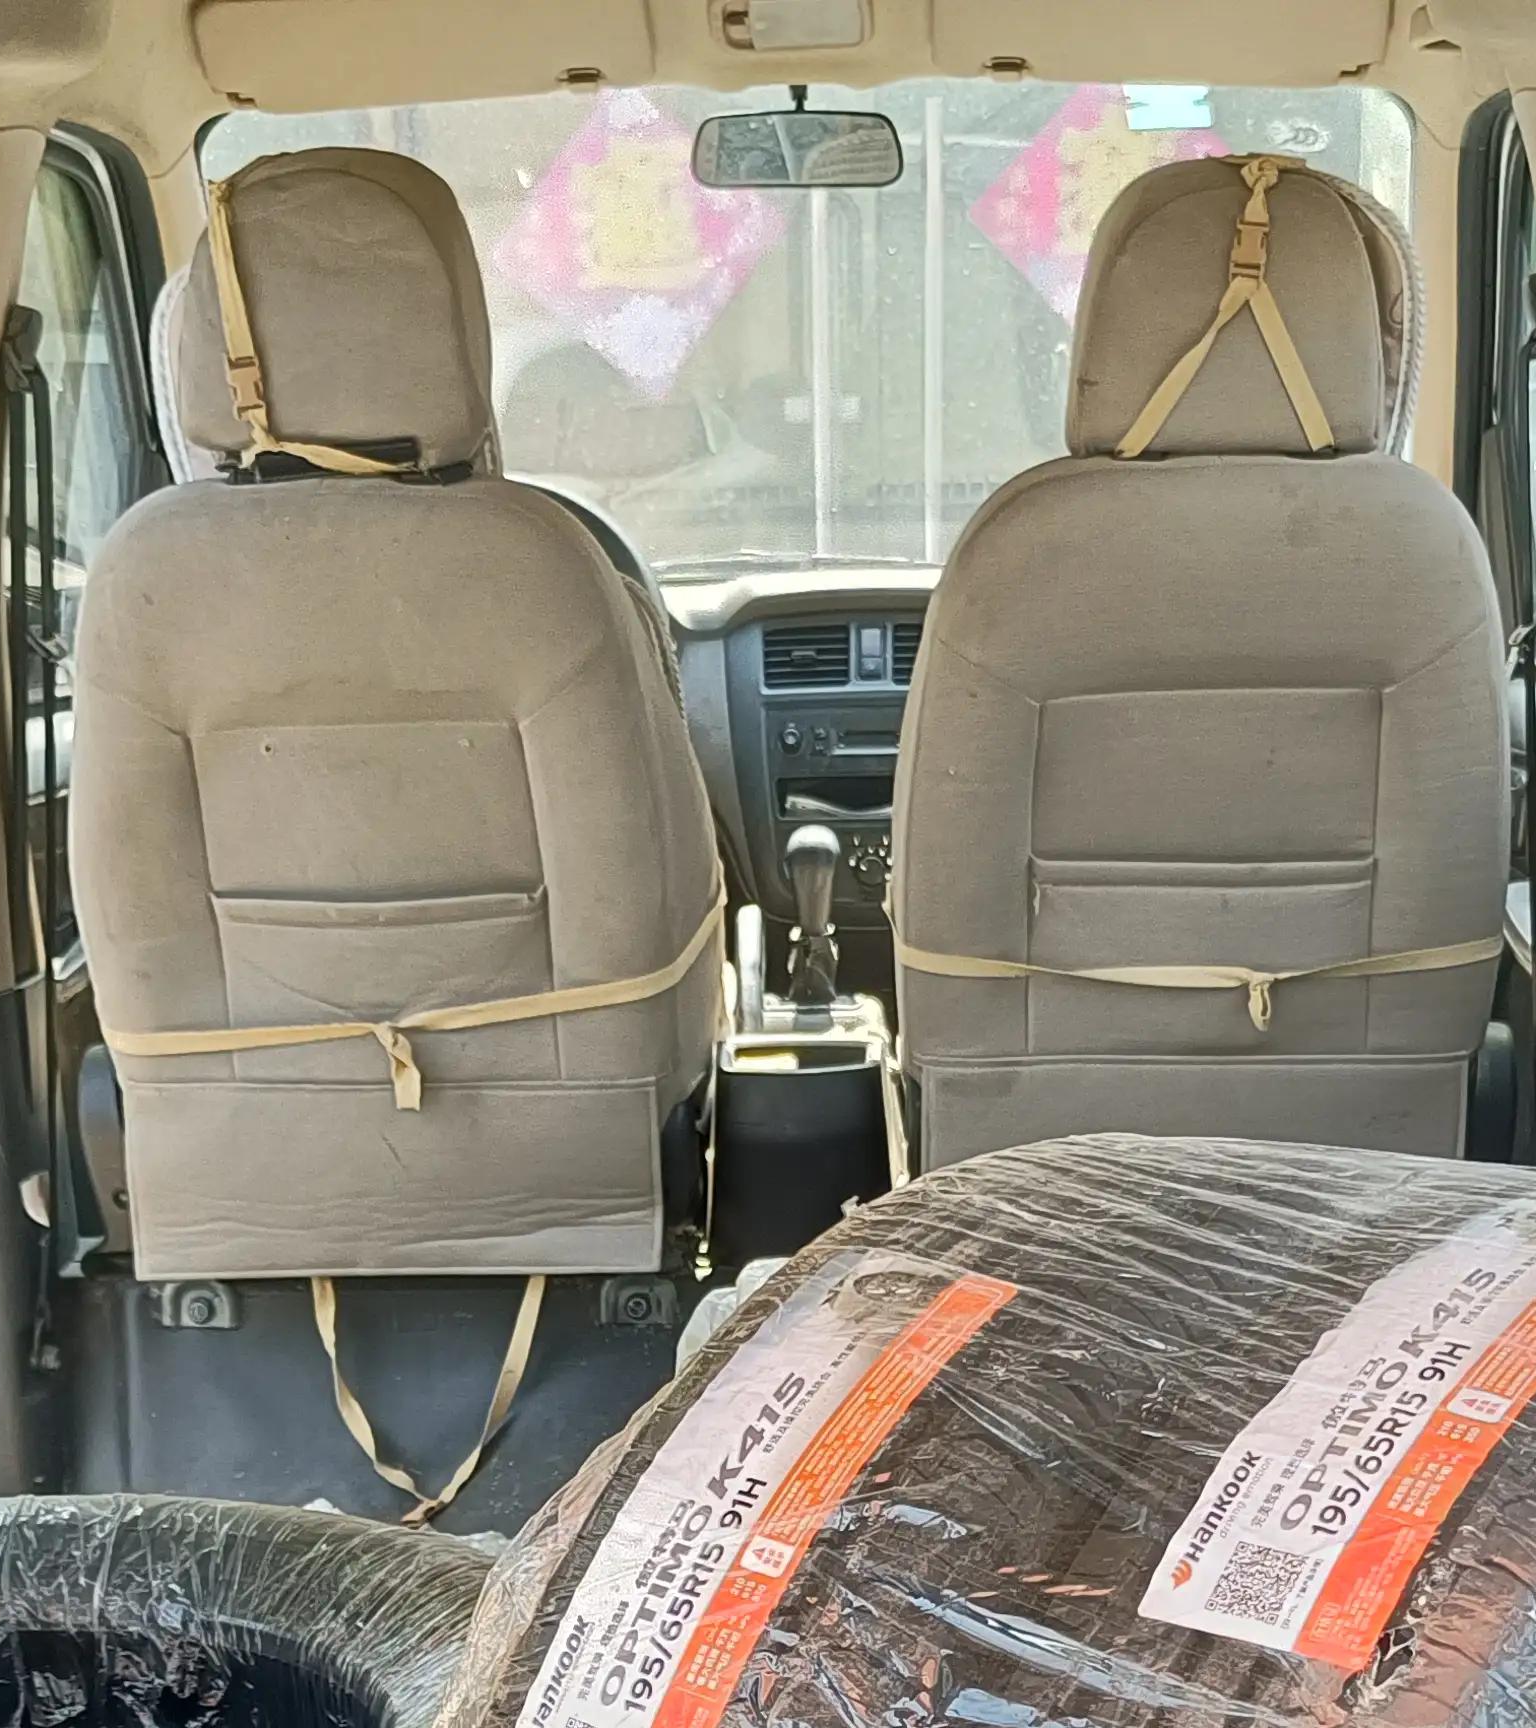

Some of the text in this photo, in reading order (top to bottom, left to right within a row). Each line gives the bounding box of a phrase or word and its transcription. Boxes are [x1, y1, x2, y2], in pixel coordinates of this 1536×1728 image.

[599, 1501, 713, 1705] OPTIMO
[705, 1369, 807, 1501] K415
[1279, 1356, 1409, 1531] OPTIMO
[1310, 1390, 1429, 1537] 195/65R15
[1418, 1341, 1471, 1384] 91H
[623, 1540, 724, 1714] 195/65R15
[721, 1477, 767, 1528] 91H
